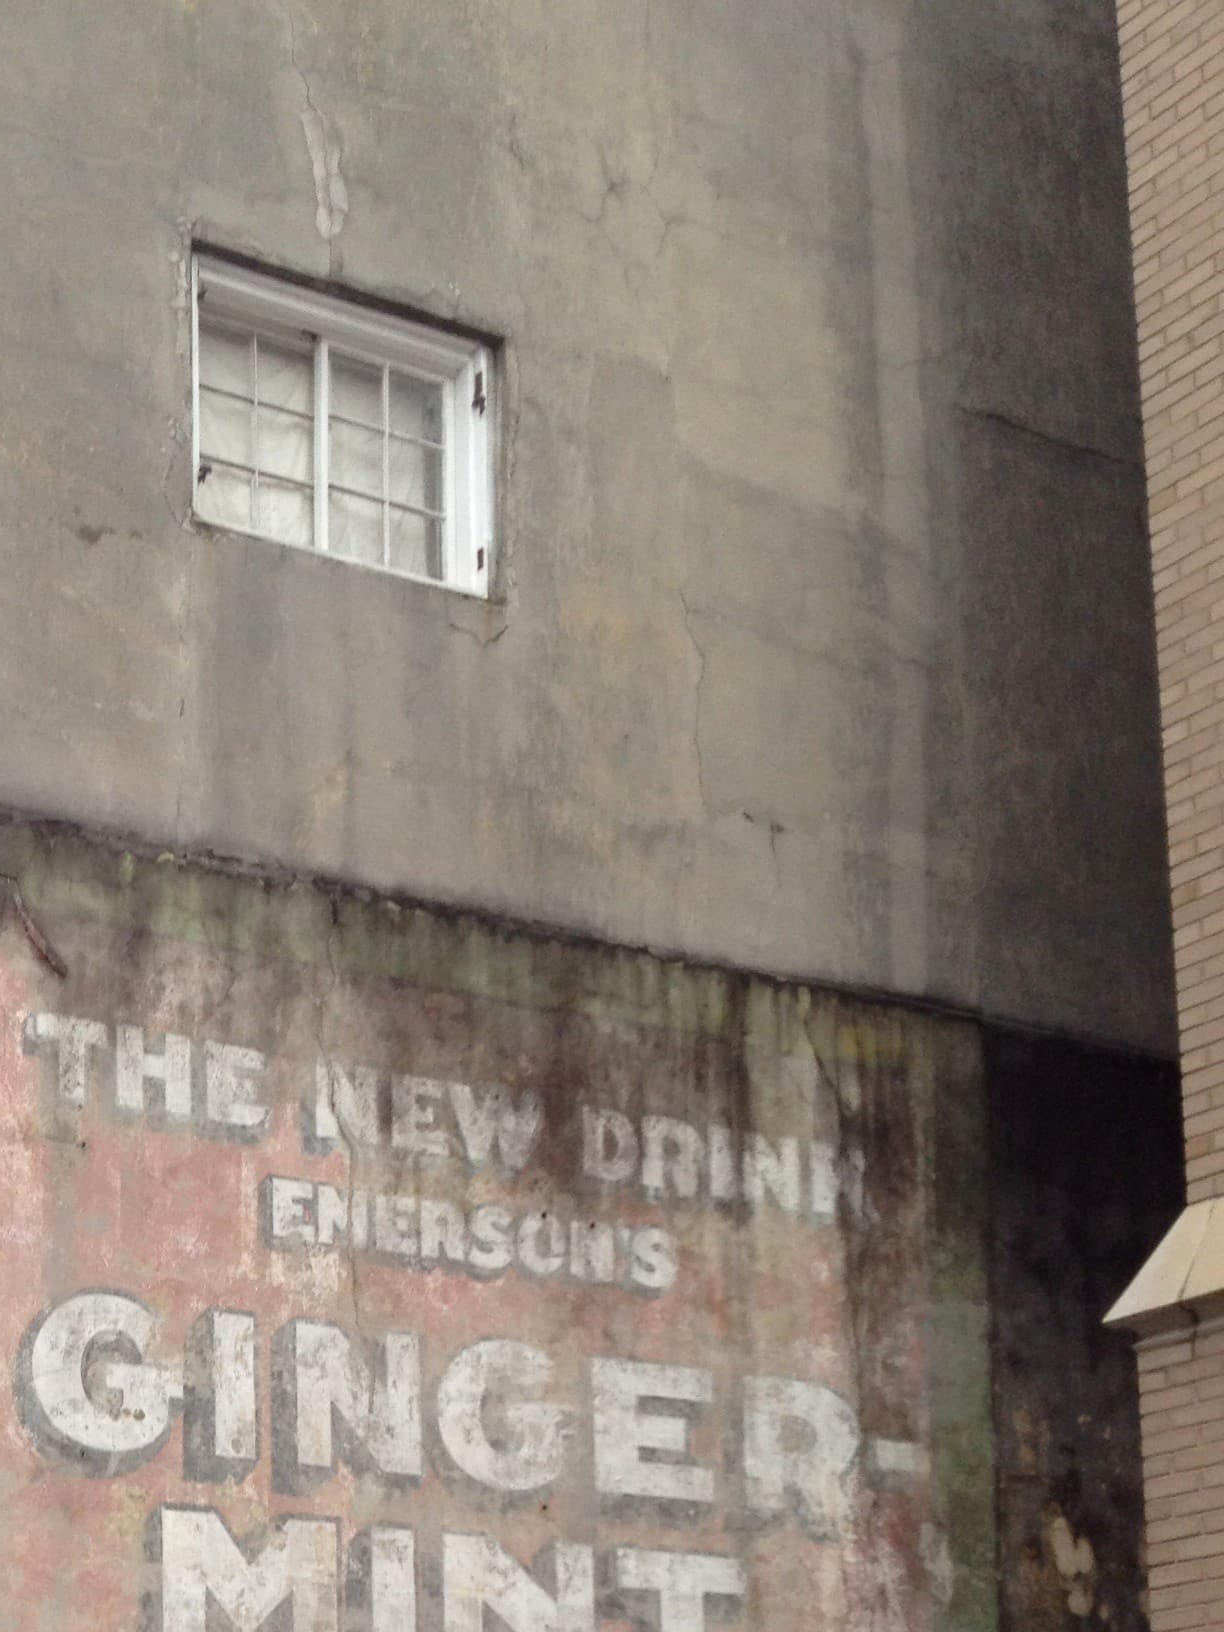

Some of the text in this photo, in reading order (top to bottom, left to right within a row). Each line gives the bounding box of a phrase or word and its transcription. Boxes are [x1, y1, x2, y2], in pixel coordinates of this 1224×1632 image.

[22, 1012, 270, 1130] THE
[308, 1059, 544, 1170] NEW
[264, 1175, 677, 1293] EMERSON'S
